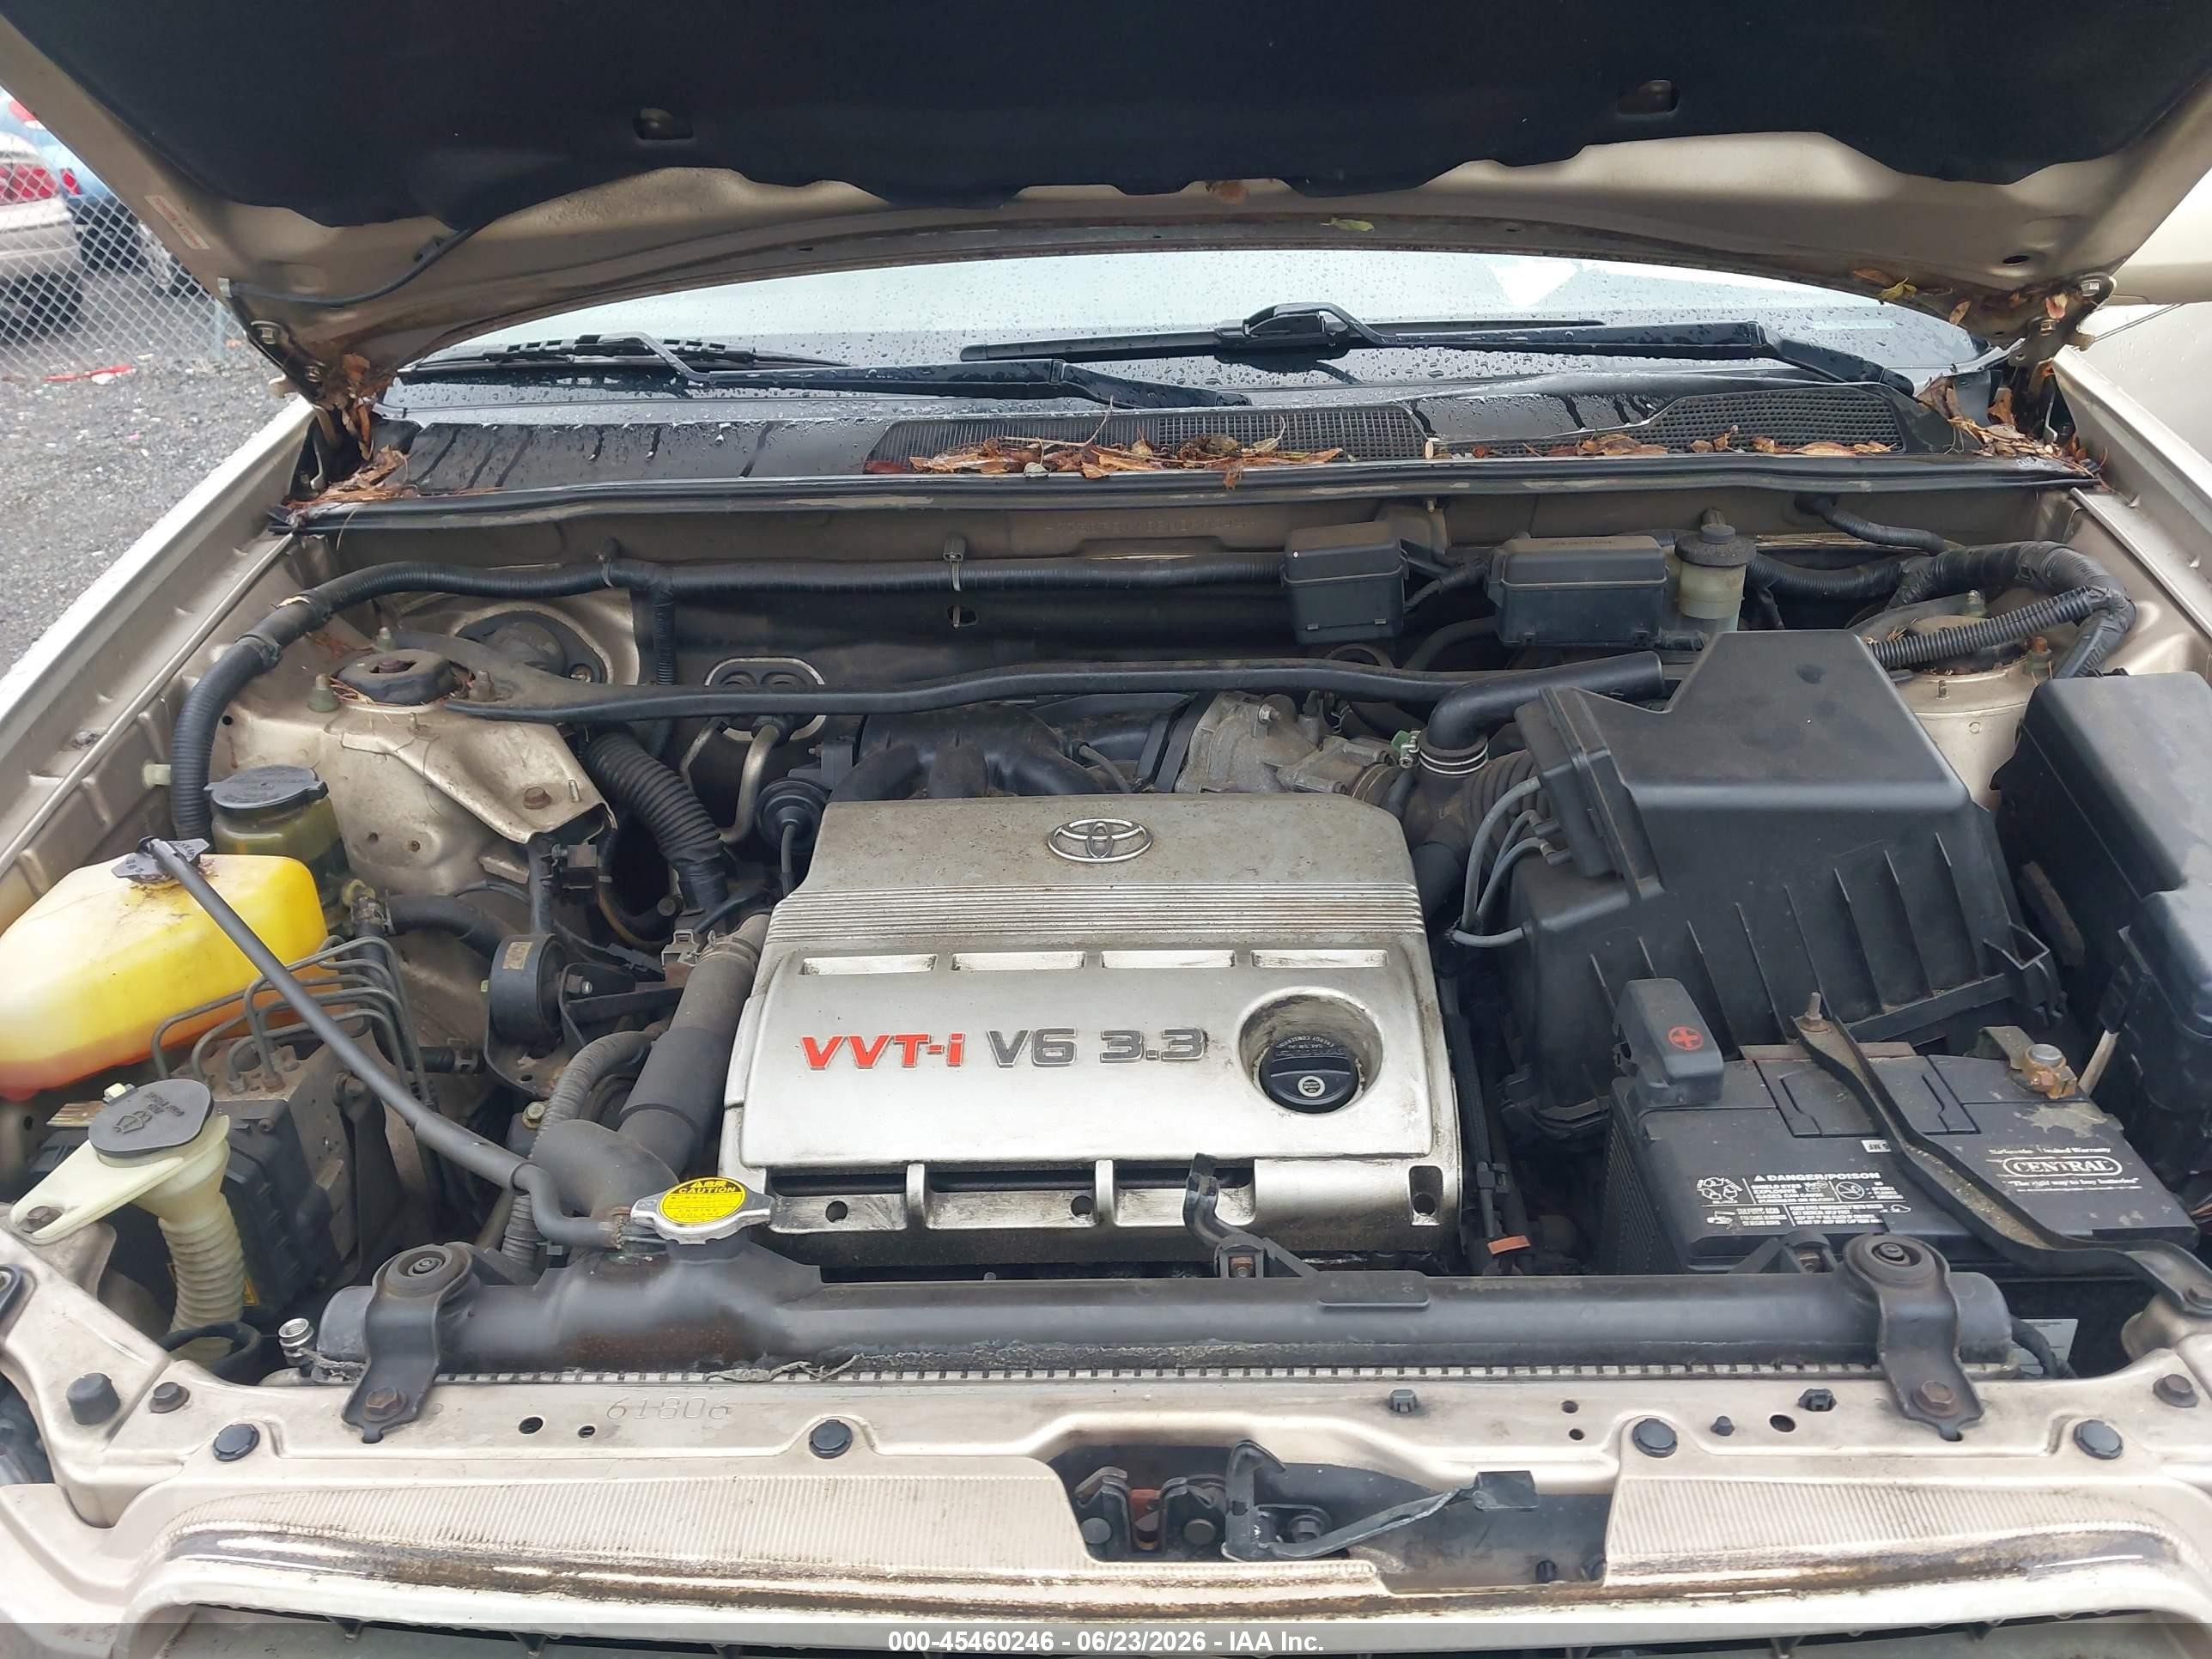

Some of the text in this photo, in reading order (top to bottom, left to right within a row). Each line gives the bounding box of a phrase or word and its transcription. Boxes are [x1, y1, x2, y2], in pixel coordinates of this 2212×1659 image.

[801, 1027, 1205, 1070] VVT-i V6 3.3
[2013, 1160, 2114, 1172] CENTRAL
[1766, 1172, 1881, 1182] DANGER/POISON
